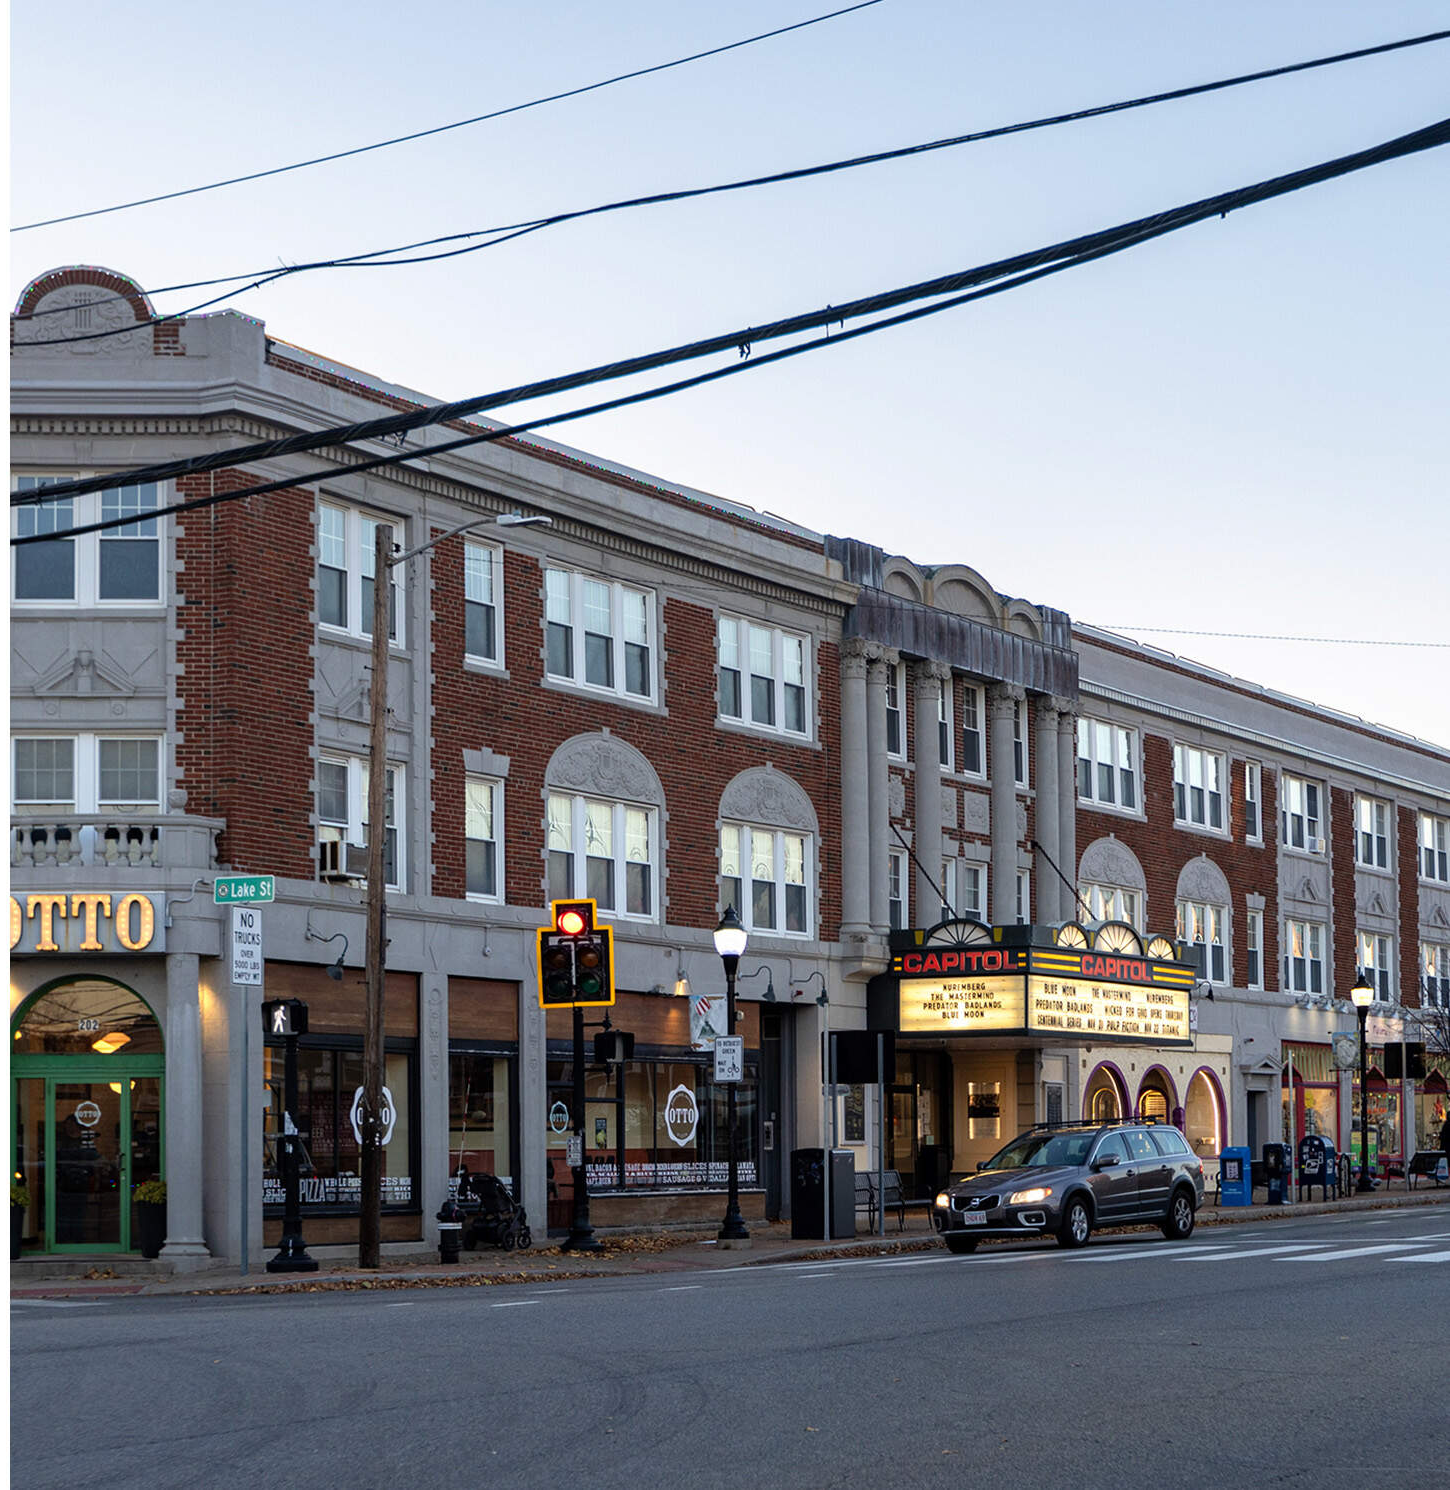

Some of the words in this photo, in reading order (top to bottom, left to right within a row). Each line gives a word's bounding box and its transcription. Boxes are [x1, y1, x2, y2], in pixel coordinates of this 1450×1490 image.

[231, 882, 256, 898] Lake
[260, 880, 271, 896] St
[240, 912, 254, 928] NO
[234, 931, 261, 946] TRUCKS
[240, 949, 254, 958] OVER
[234, 961, 249, 969] 5000
[250, 962, 260, 970] LBS
[904, 950, 1018, 973] CAPITOL
[1081, 955, 1151, 982] CAPITOL
[943, 983, 986, 991] NUREMBERG
[1044, 983, 1058, 995] BLUE
[1062, 986, 1076, 997] MOON
[931, 993, 943, 1001] THE
[949, 992, 995, 1000] MASTERMIND
[1092, 987, 1100, 998] THE
[1102, 989, 1131, 1002] MASTERMIND
[1146, 993, 1174, 1005] NUREMBERG
[923, 1002, 959, 1010] PREDATOR
[964, 1001, 1002, 1009] BADLANDS
[1035, 1000, 1063, 1012] PREDATOR
[1067, 1001, 1093, 1014] BADLANDS
[1105, 1005, 1123, 1016] WICKED
[1126, 1007, 1134, 1018] FOR
[942, 1011, 959, 1019] BLUE
[964, 1010, 984, 1018] MOON
[79, 1020, 99, 1030] 202
[1107, 1020, 1120, 1032] PULP
[78, 1110, 98, 1118] OTTO
[357, 1107, 390, 1125] OO
[552, 1113, 567, 1122] OTTO
[669, 1108, 695, 1124] OTTO
[683, 1162, 707, 1170] SLICES
[663, 1175, 695, 1184] SAUSAGE
[266, 1188, 286, 1197] SLIC
[299, 1178, 326, 1203] PIZZA
